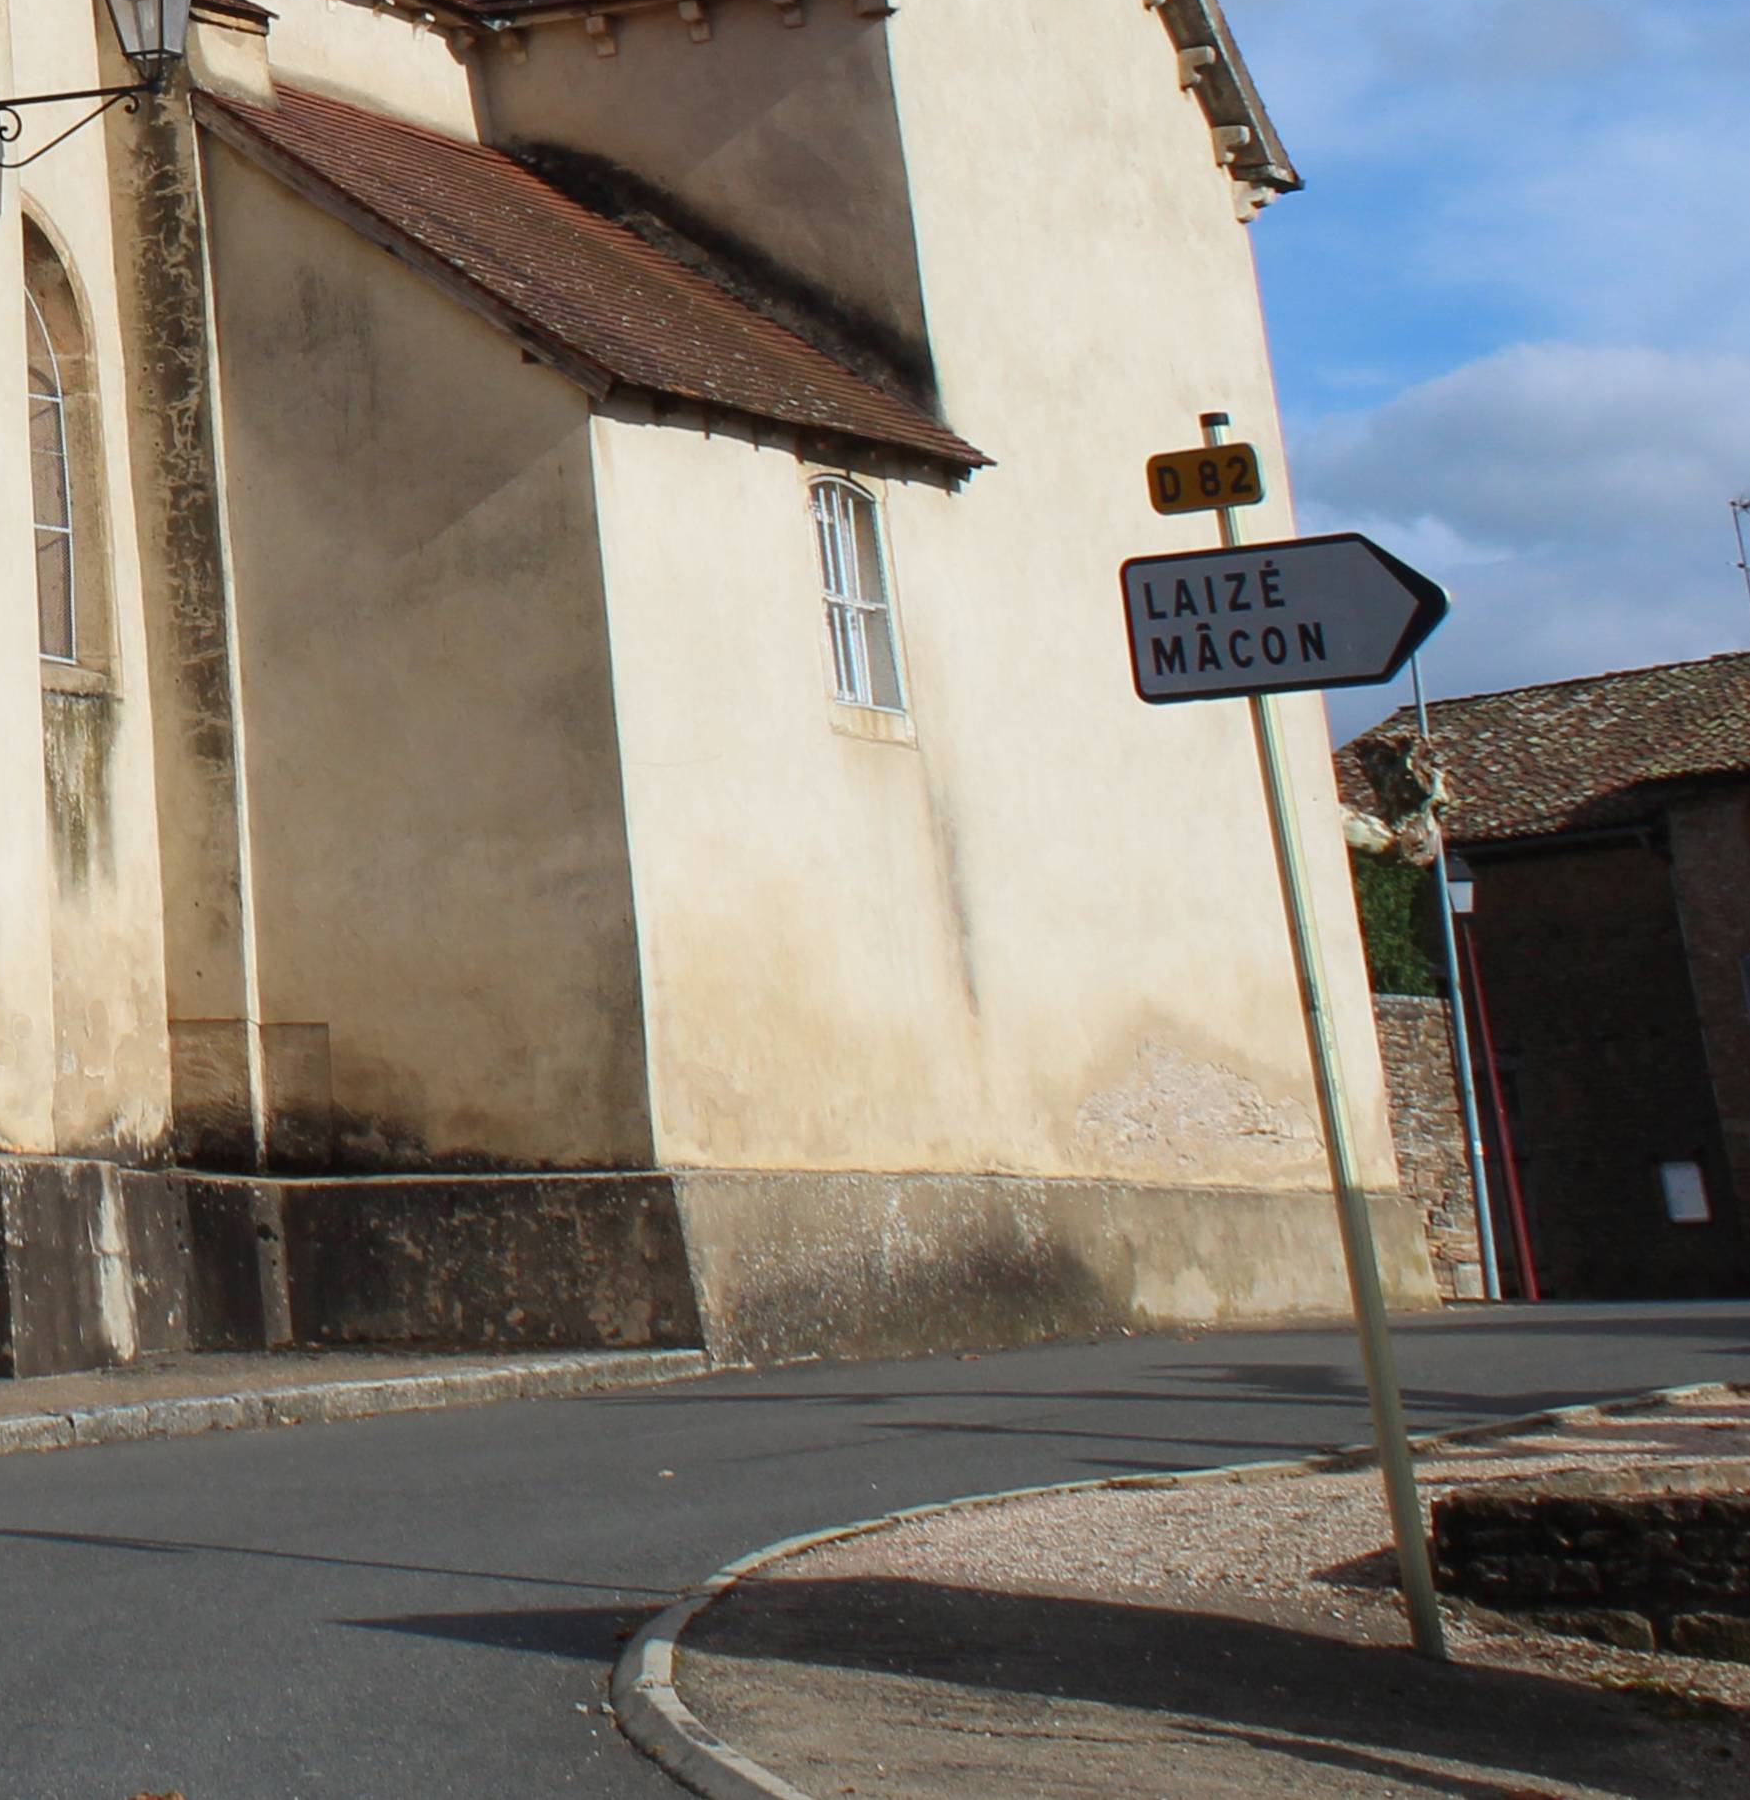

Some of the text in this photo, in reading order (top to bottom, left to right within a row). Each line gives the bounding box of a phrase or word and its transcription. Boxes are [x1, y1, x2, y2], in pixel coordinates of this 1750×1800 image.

[1156, 456, 1253, 503] D 82
[1142, 560, 1286, 620] LAIZÉ
[1152, 621, 1327, 676] MÂCON
